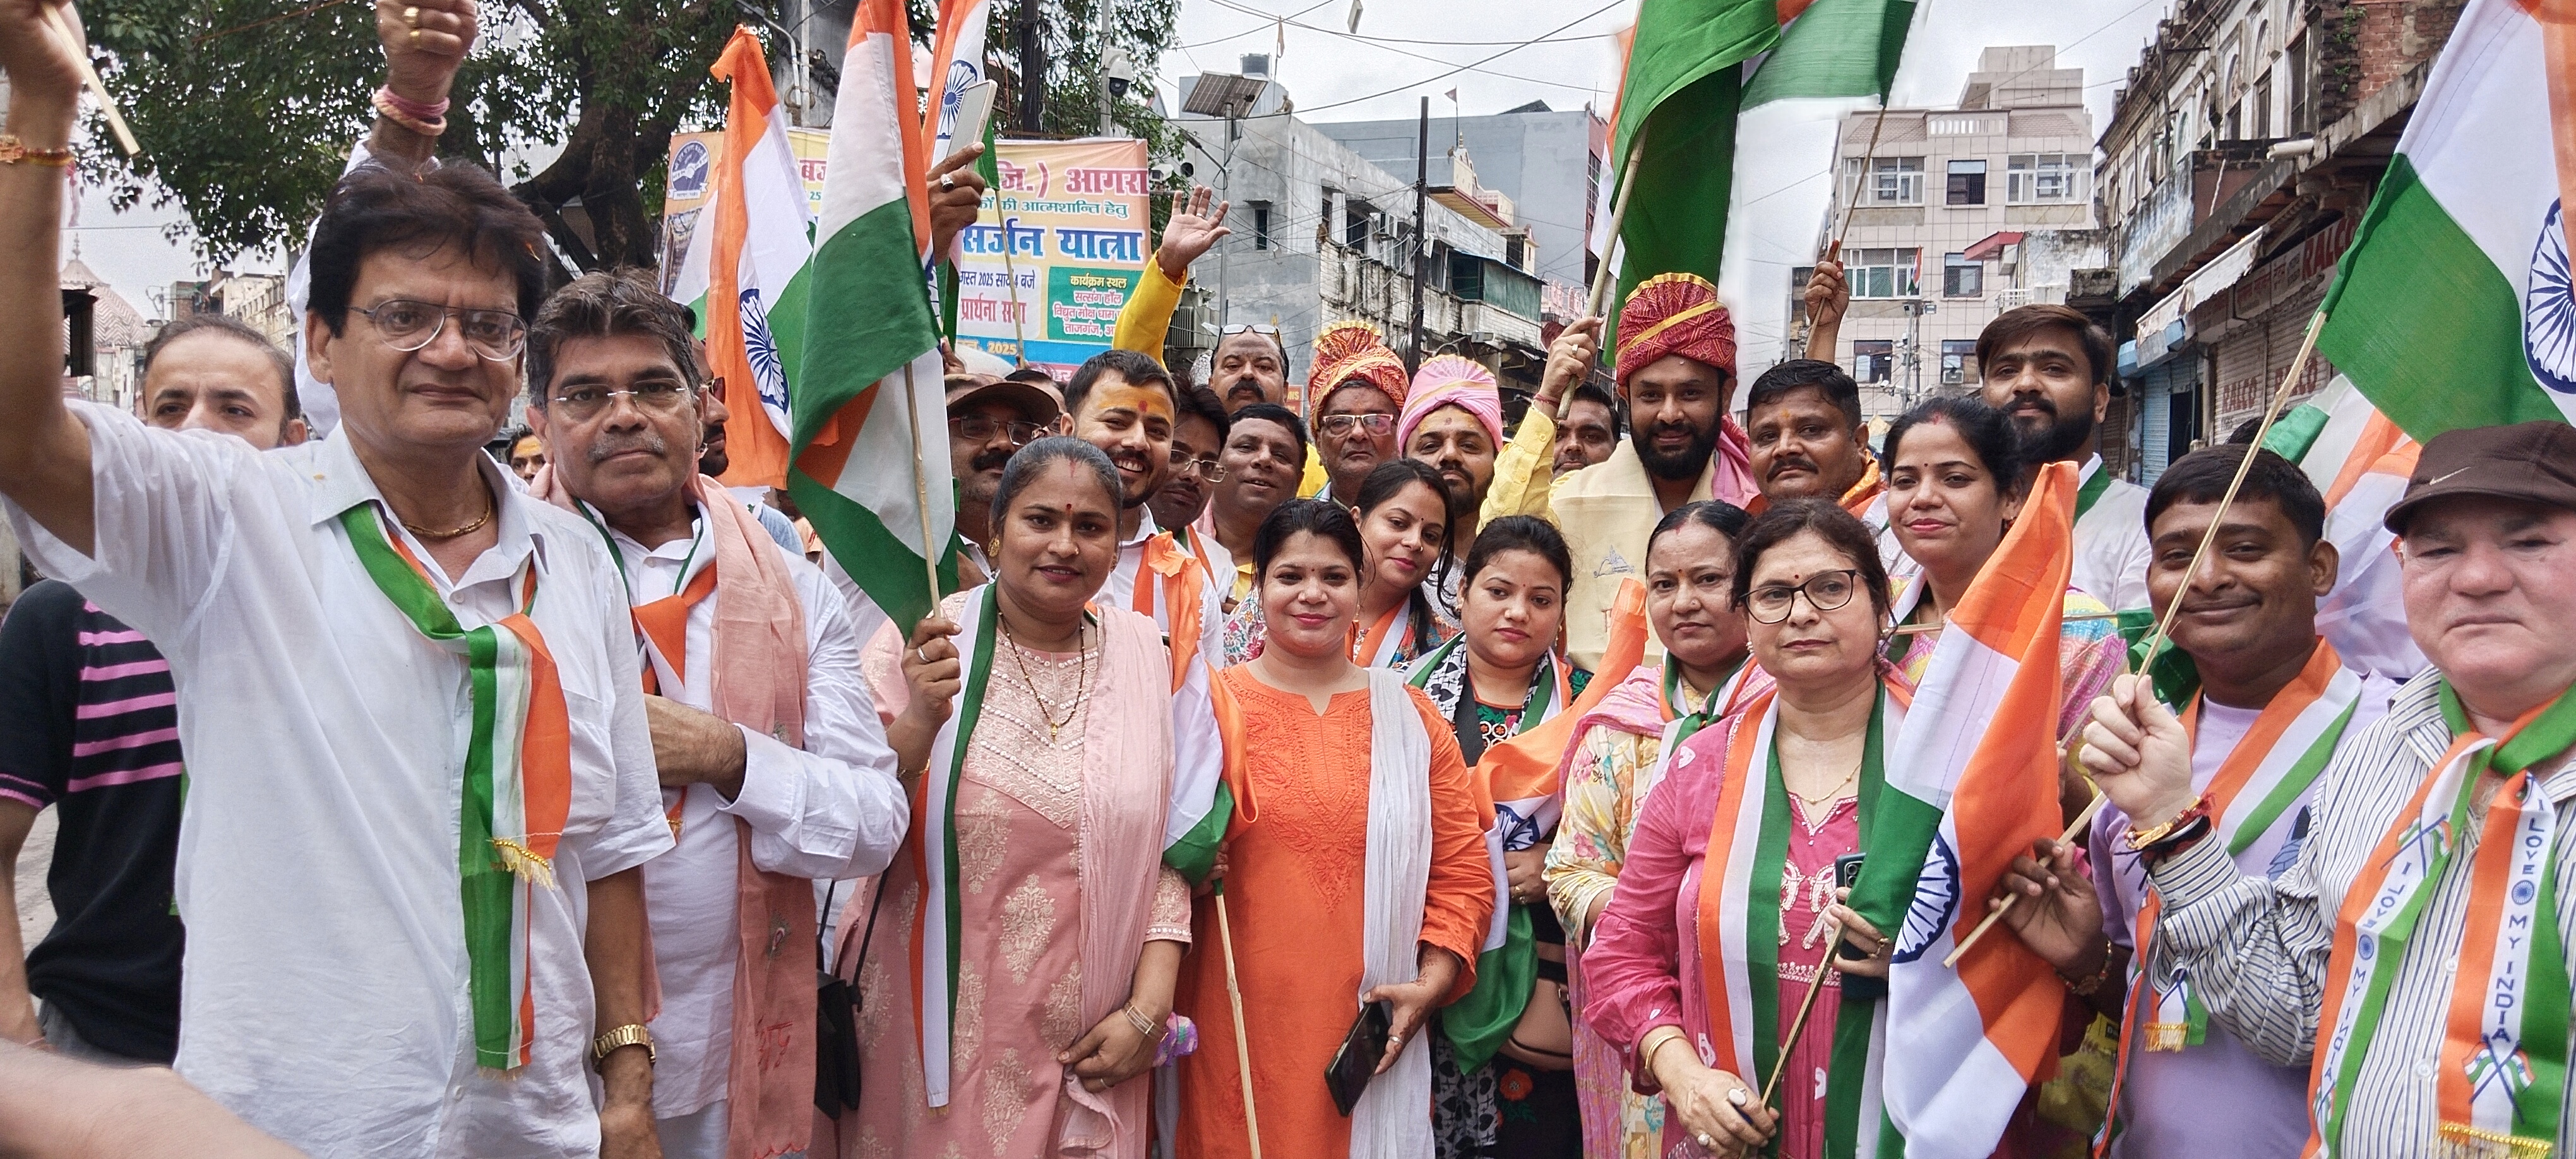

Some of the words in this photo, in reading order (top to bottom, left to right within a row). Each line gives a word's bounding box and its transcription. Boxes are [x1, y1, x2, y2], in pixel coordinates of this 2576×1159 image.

[1066, 168, 1149, 194] आगरा
[1022, 199, 1100, 213] आत्मशान्ति
[1104, 201, 1128, 218] हेतु
[963, 218, 1045, 257] सर्जन
[1056, 229, 1143, 261] यात्रा
[978, 272, 994, 287] 2025
[1021, 269, 1035, 290] बजे
[1070, 273, 1105, 288] कार्यक्रम
[1106, 277, 1127, 288] स्थल
[961, 292, 998, 322] प्रार्थना
[1075, 290, 1102, 302] सत्संग
[1104, 290, 1122, 304] हॉल
[1098, 309, 1115, 319] धाम
[989, 342, 1017, 355] 2025
[2222, 377, 2257, 414] RALCO
[2537, 798, 2545, 811] I
[2522, 818, 2545, 875] LOVE
[2508, 914, 2528, 949] MY
[2491, 960, 2515, 1043] INDIA
